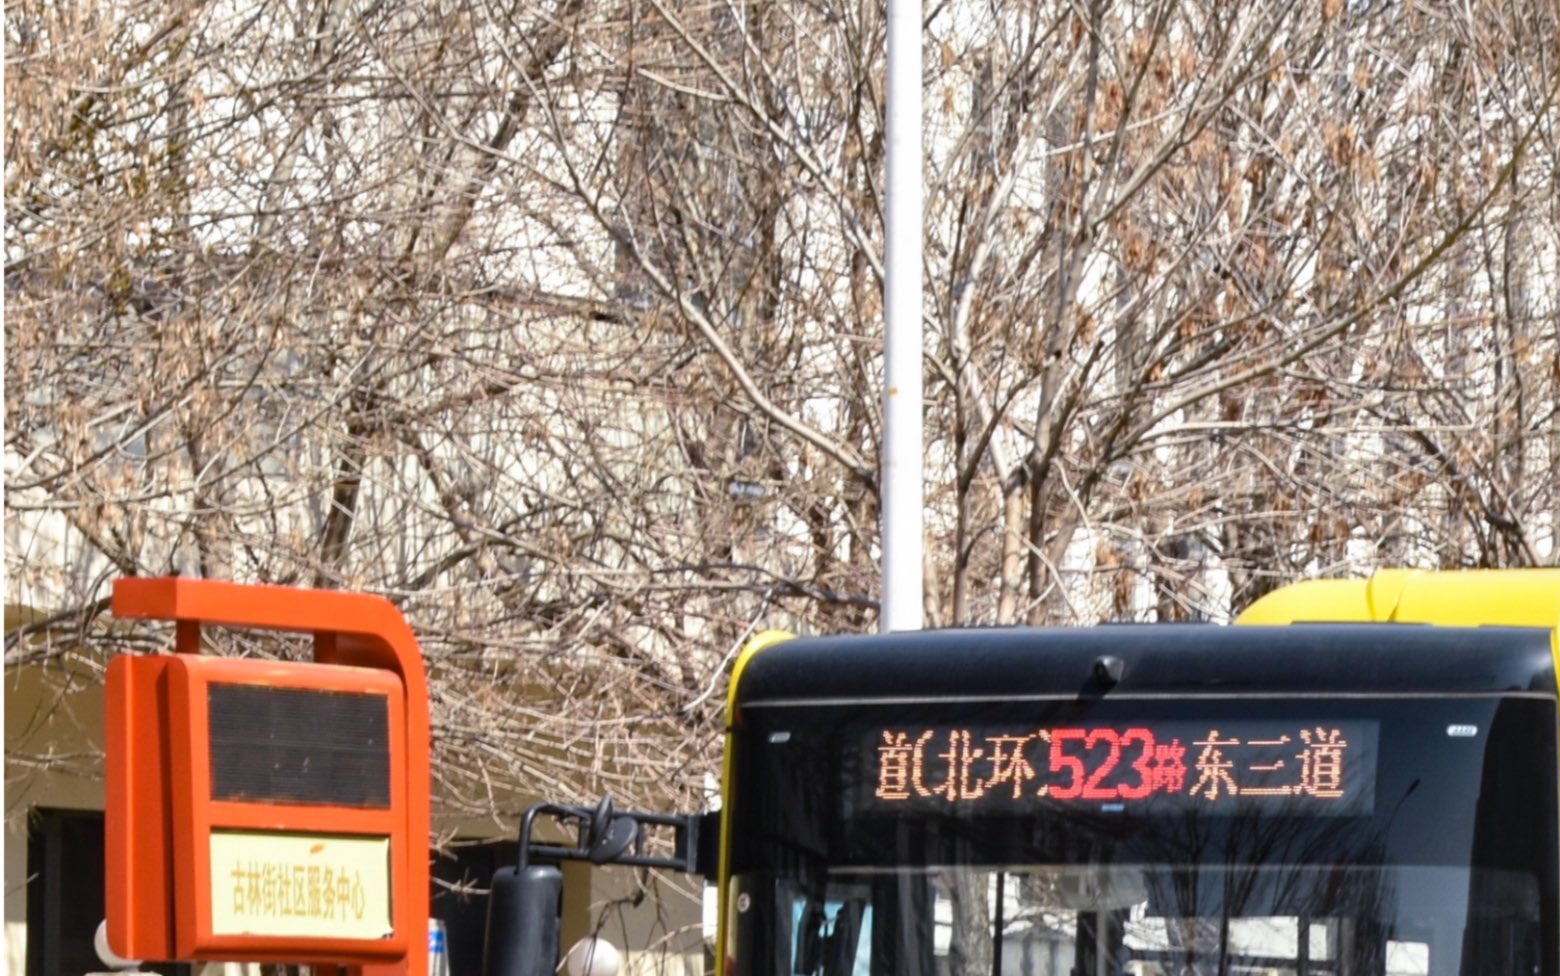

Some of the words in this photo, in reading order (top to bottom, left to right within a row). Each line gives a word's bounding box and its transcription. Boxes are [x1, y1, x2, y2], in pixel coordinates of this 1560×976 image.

[1190, 727, 1348, 800] 东三道
[231, 859, 366, 921] 古林街社区服务中心
